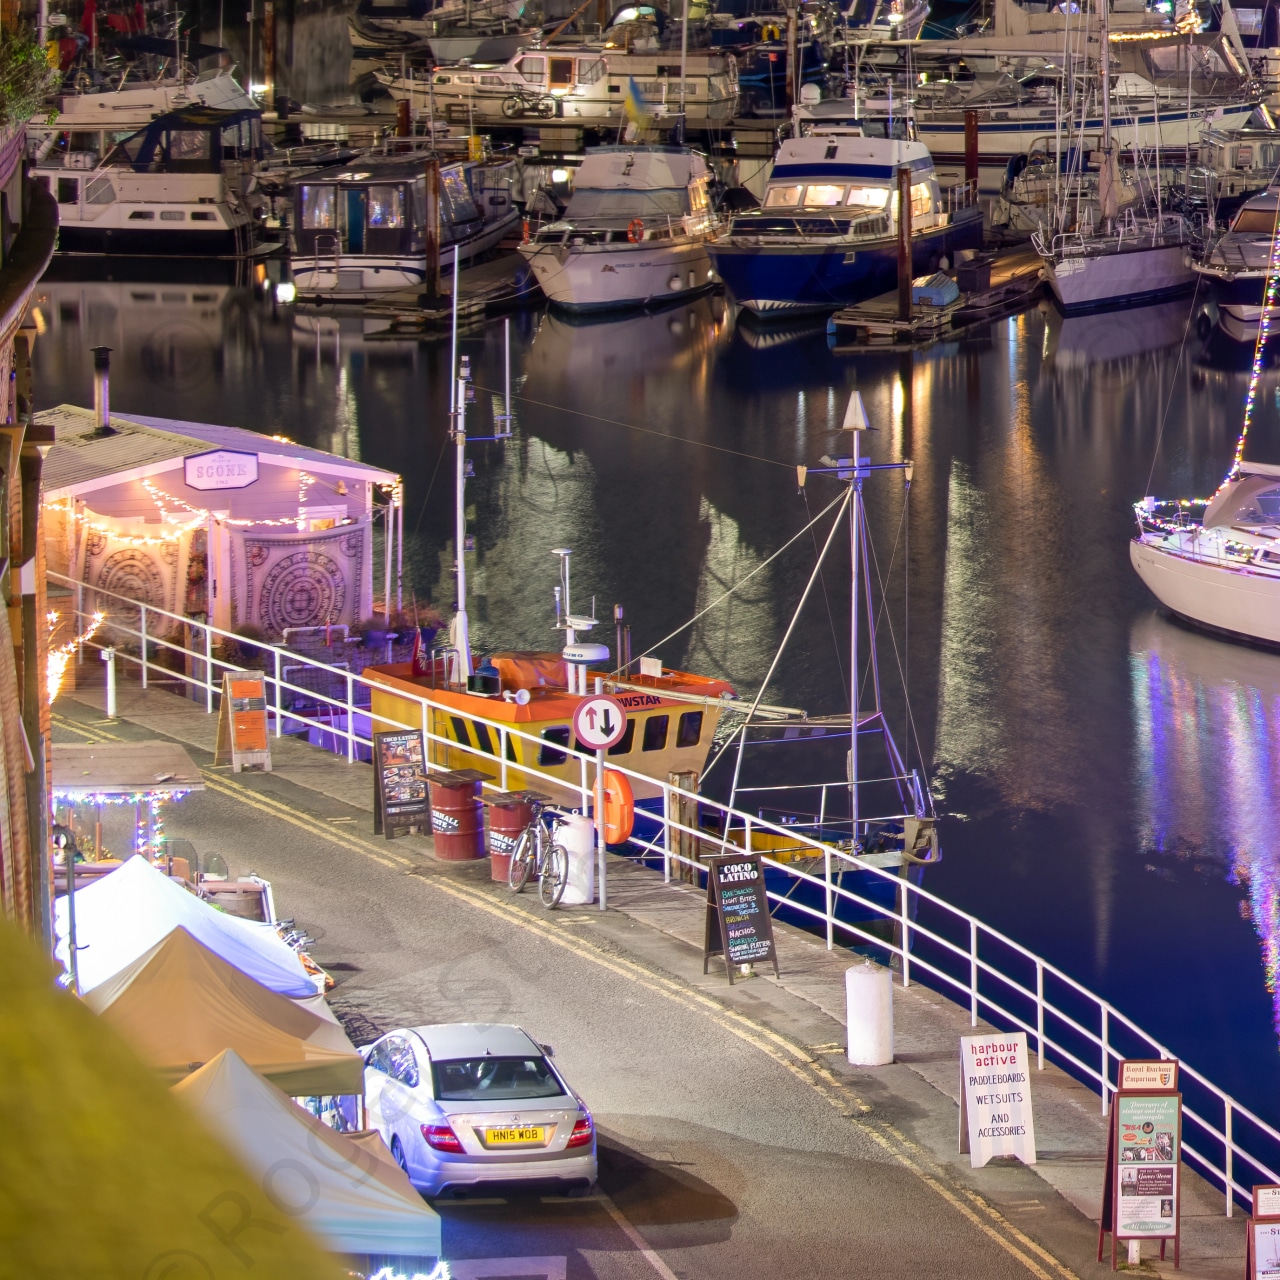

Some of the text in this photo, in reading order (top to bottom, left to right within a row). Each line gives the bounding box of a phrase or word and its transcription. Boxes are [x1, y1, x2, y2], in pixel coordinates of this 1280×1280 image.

[197, 463, 247, 478] SCONE
[724, 863, 752, 874] COCO
[720, 870, 758, 883] LATINO
[740, 894, 757, 903] BITES
[729, 927, 756, 938] NACHOS
[971, 1042, 1018, 1055] harbour
[975, 1055, 1017, 1066] active
[1146, 1065, 1172, 1073] Harbour
[969, 1072, 1026, 1086] PADDLEBOARDS
[1125, 1075, 1157, 1083] Emporium
[976, 1092, 1023, 1105] WETSUITS
[991, 1113, 1009, 1124] AND
[493, 1130, 538, 1141] HN15 WOB
[978, 1125, 1026, 1138] ACCESSORIES
